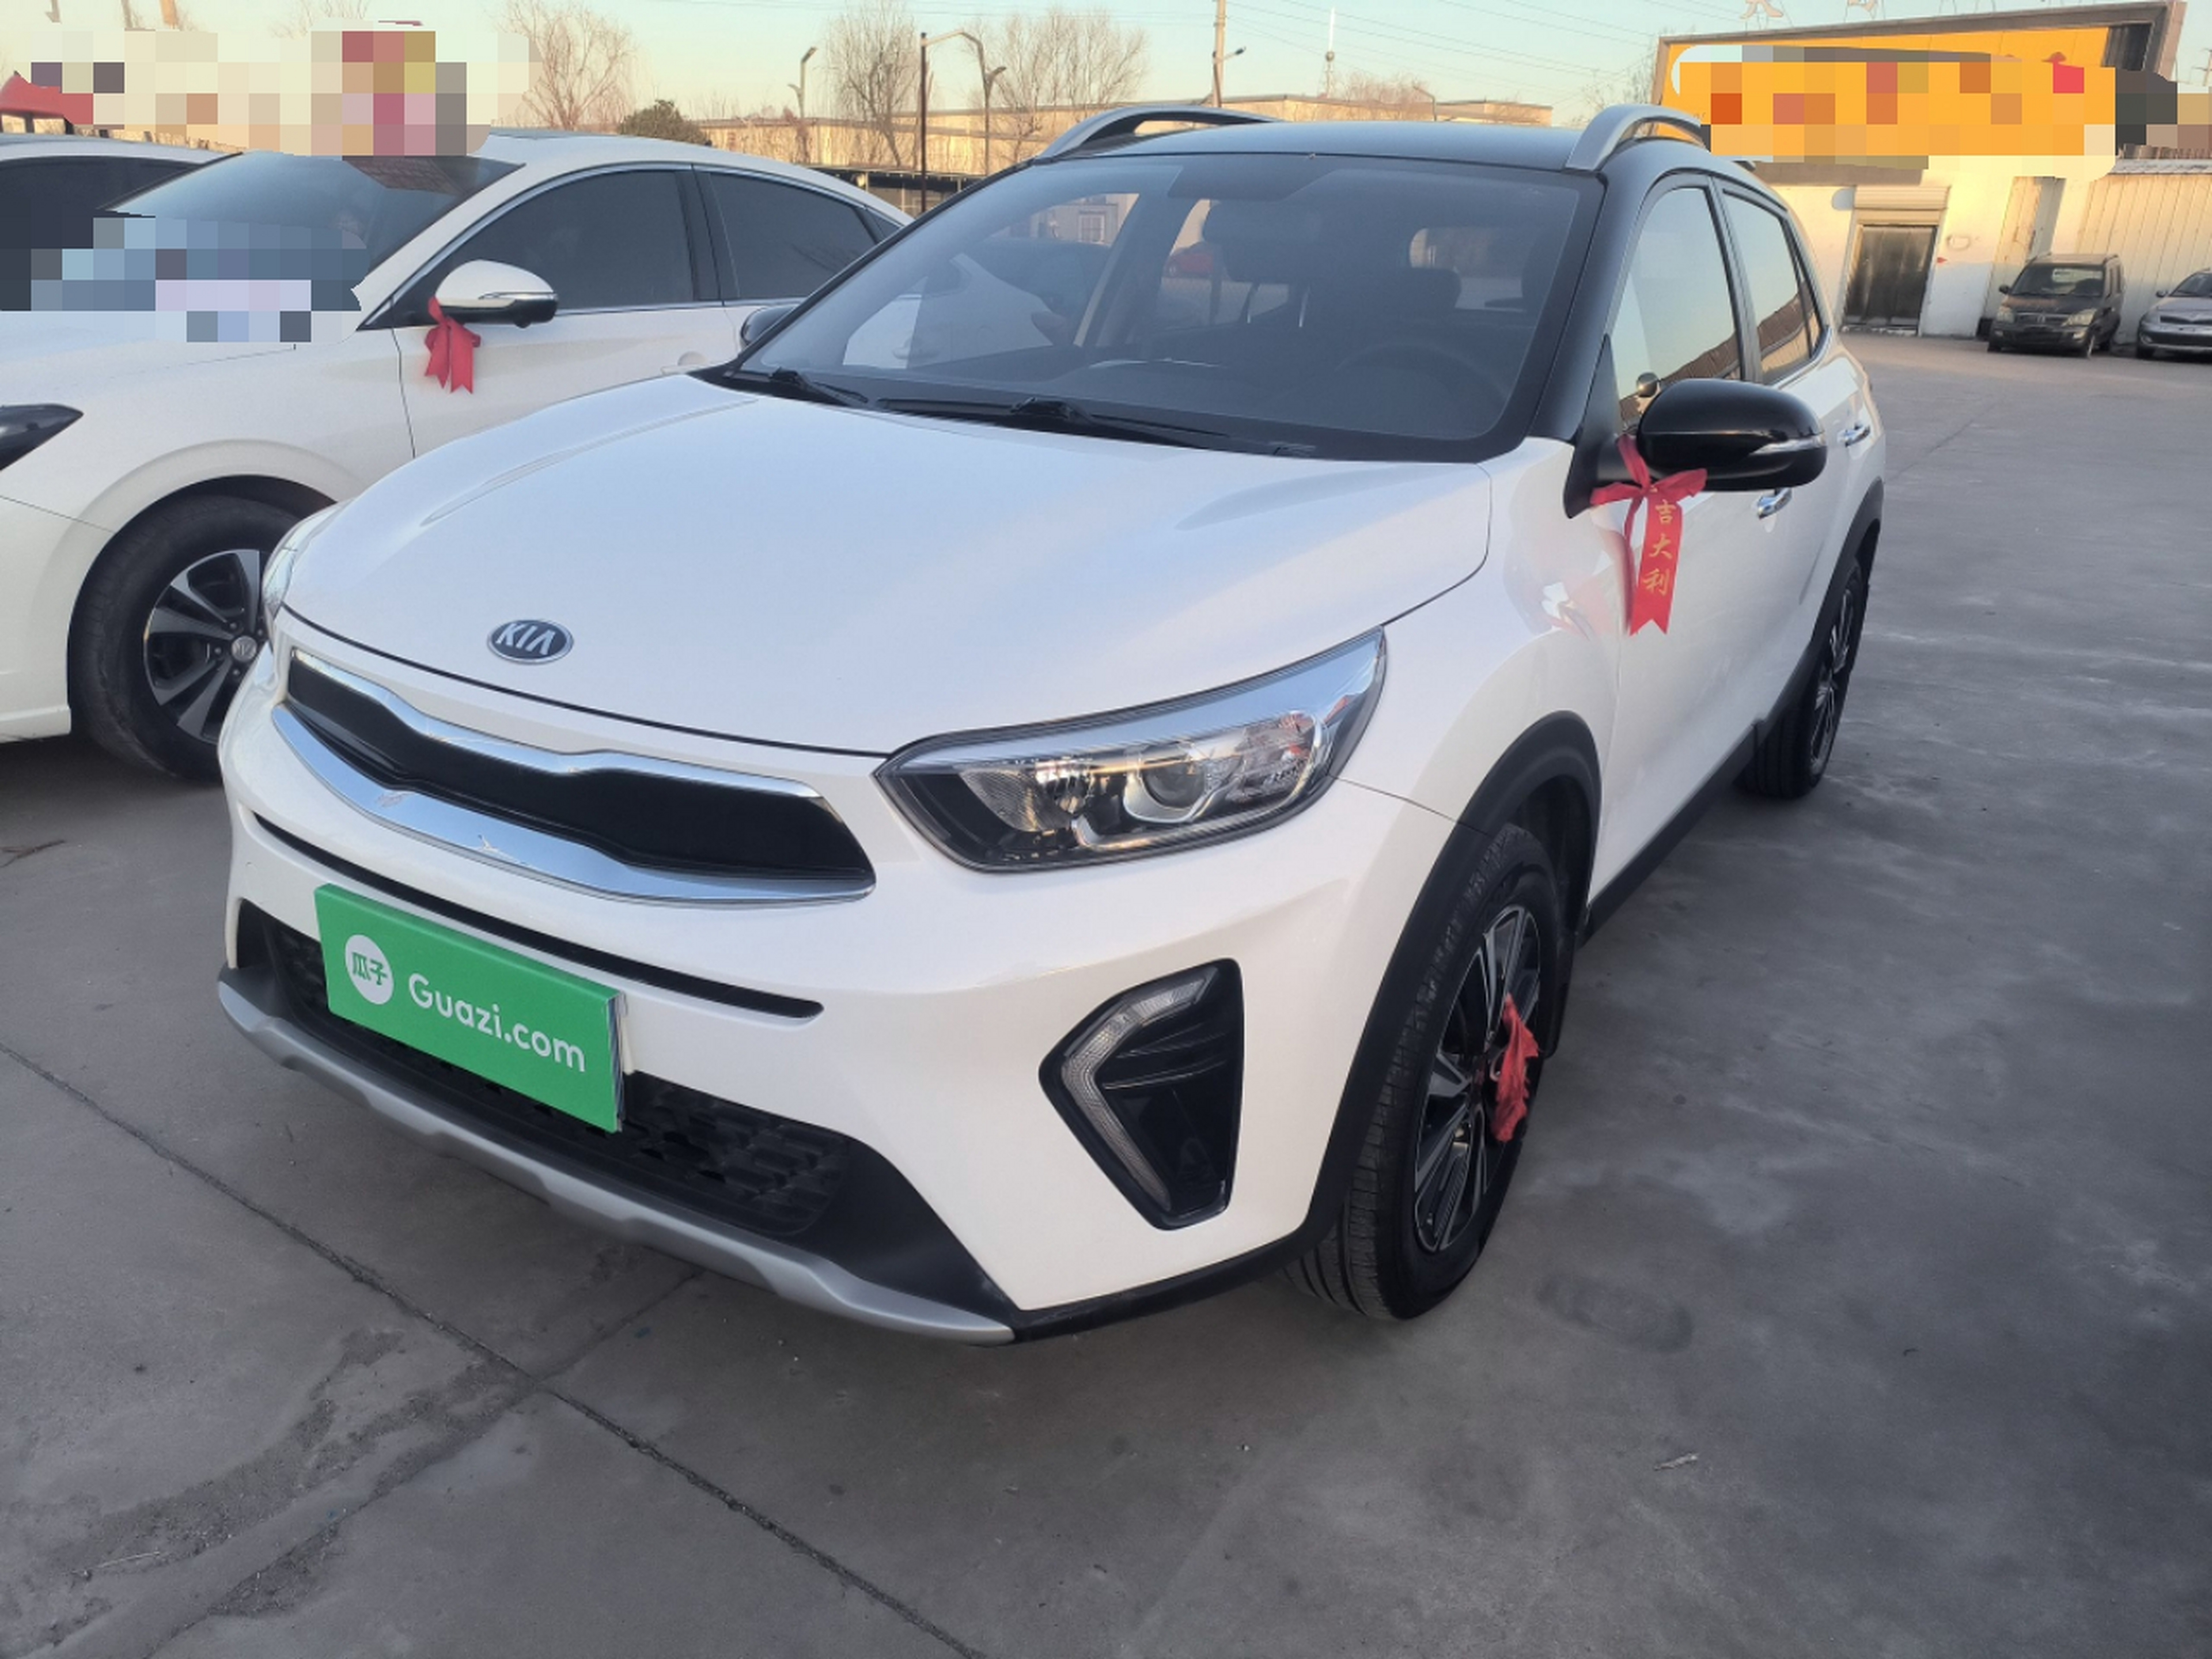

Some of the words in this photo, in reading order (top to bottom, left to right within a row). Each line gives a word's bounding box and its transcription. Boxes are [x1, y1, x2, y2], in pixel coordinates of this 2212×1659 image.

[1643, 485, 1677, 596] 吉大利
[495, 623, 556, 655] KIA
[352, 952, 388, 986] 瓜子
[408, 973, 586, 1072] Guazi.com
